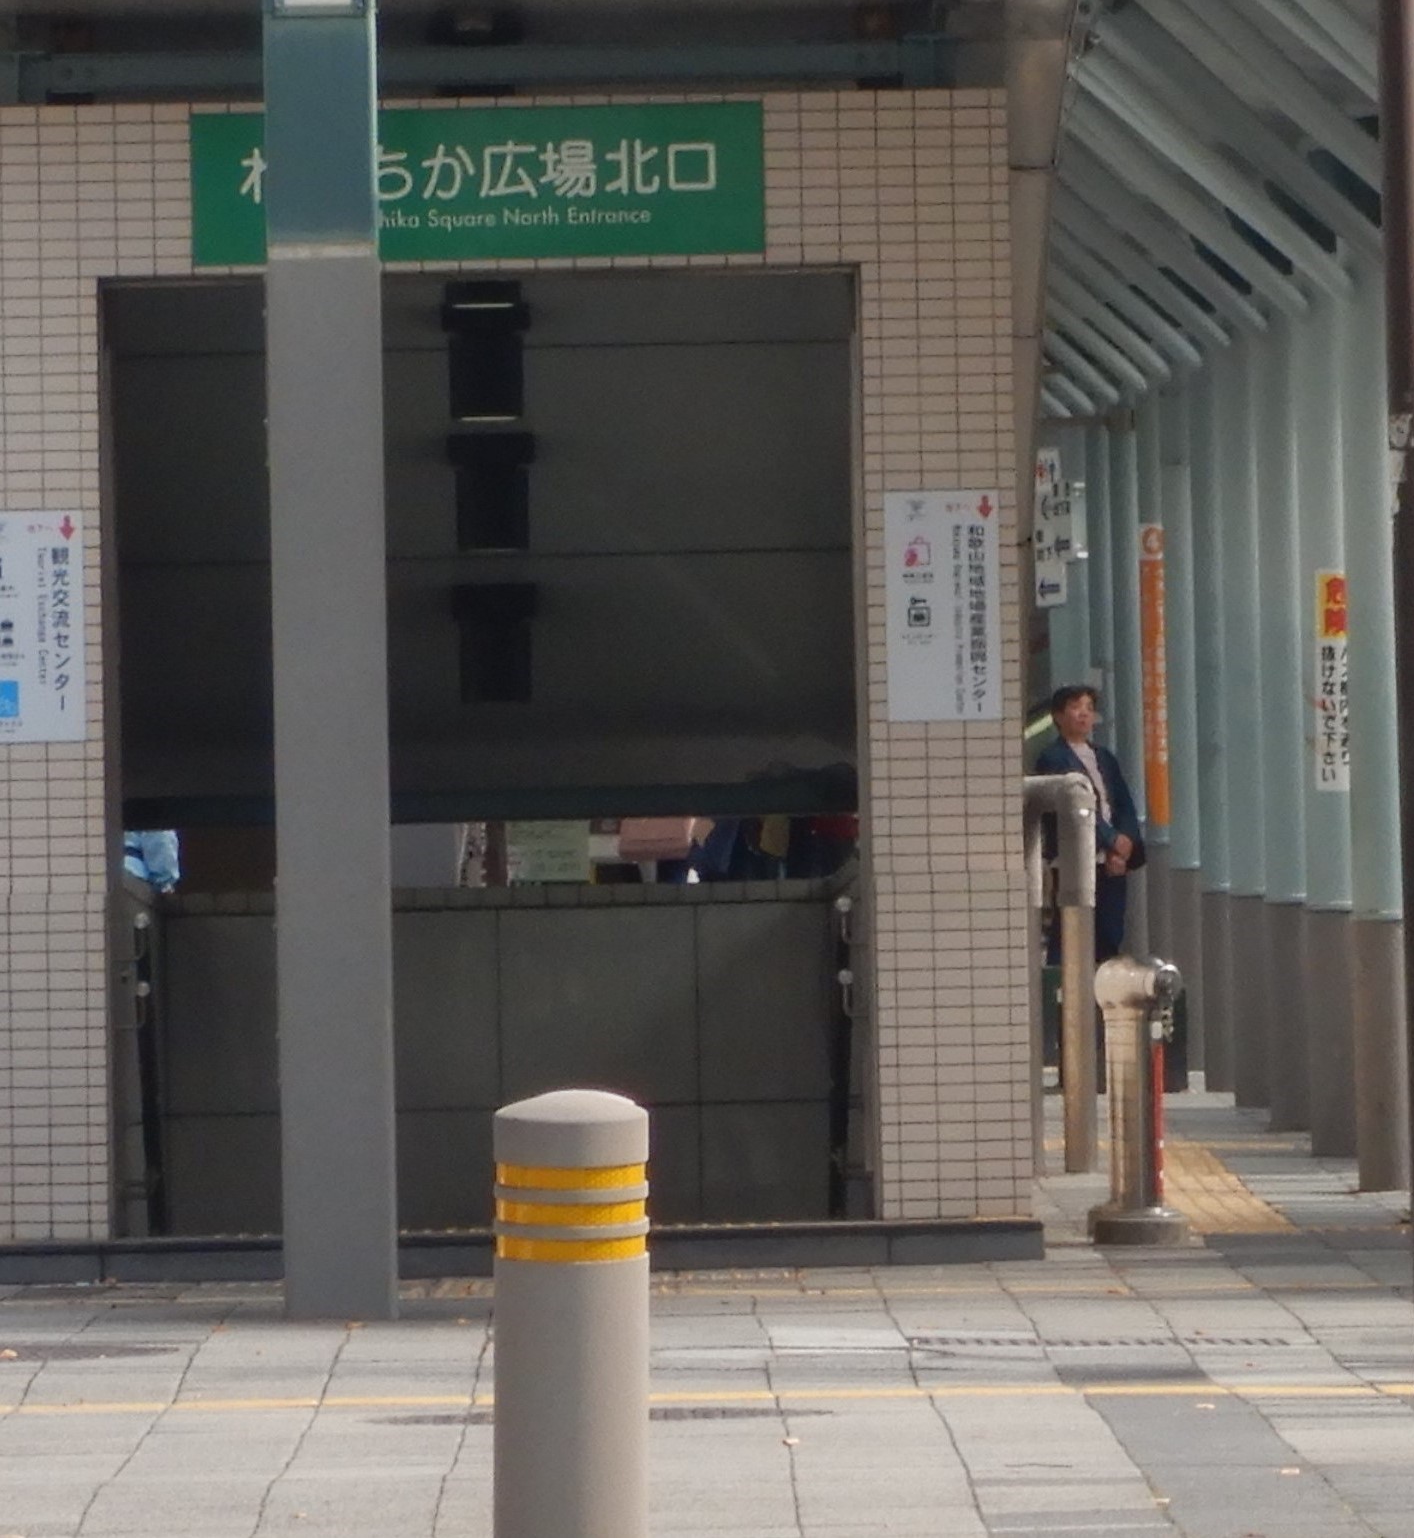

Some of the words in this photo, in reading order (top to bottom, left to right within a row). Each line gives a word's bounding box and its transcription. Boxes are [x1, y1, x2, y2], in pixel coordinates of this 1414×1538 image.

[428, 210, 496, 231] Square
[503, 205, 559, 226] North
[567, 205, 652, 226] Entrance
[51, 546, 71, 711] 観光交流センター
